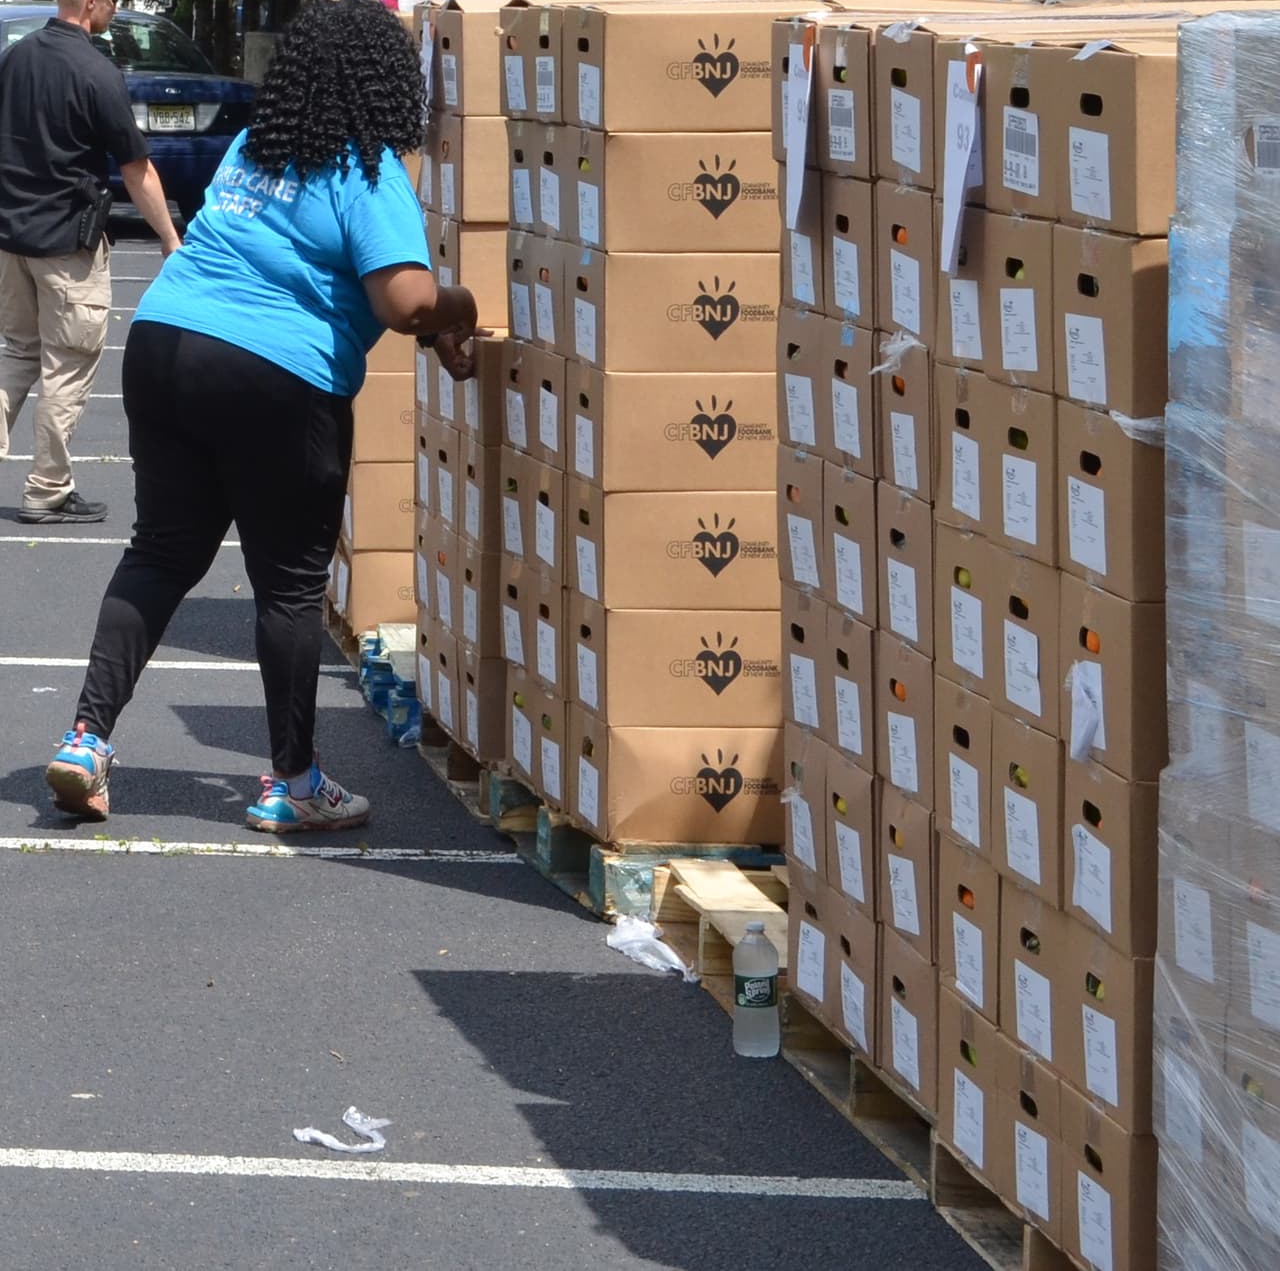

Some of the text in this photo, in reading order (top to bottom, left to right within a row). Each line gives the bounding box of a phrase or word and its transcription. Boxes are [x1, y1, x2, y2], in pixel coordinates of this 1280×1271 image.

[666, 61, 732, 80] CFBNJ
[246, 171, 298, 203] CARE
[667, 182, 732, 201] CFBNJ
[666, 304, 732, 321] CFBNJ
[664, 423, 729, 441] CFBNJ
[666, 540, 732, 559] CFBNJ
[669, 659, 735, 677] CFBNJ
[670, 776, 736, 795] CFBNJ
